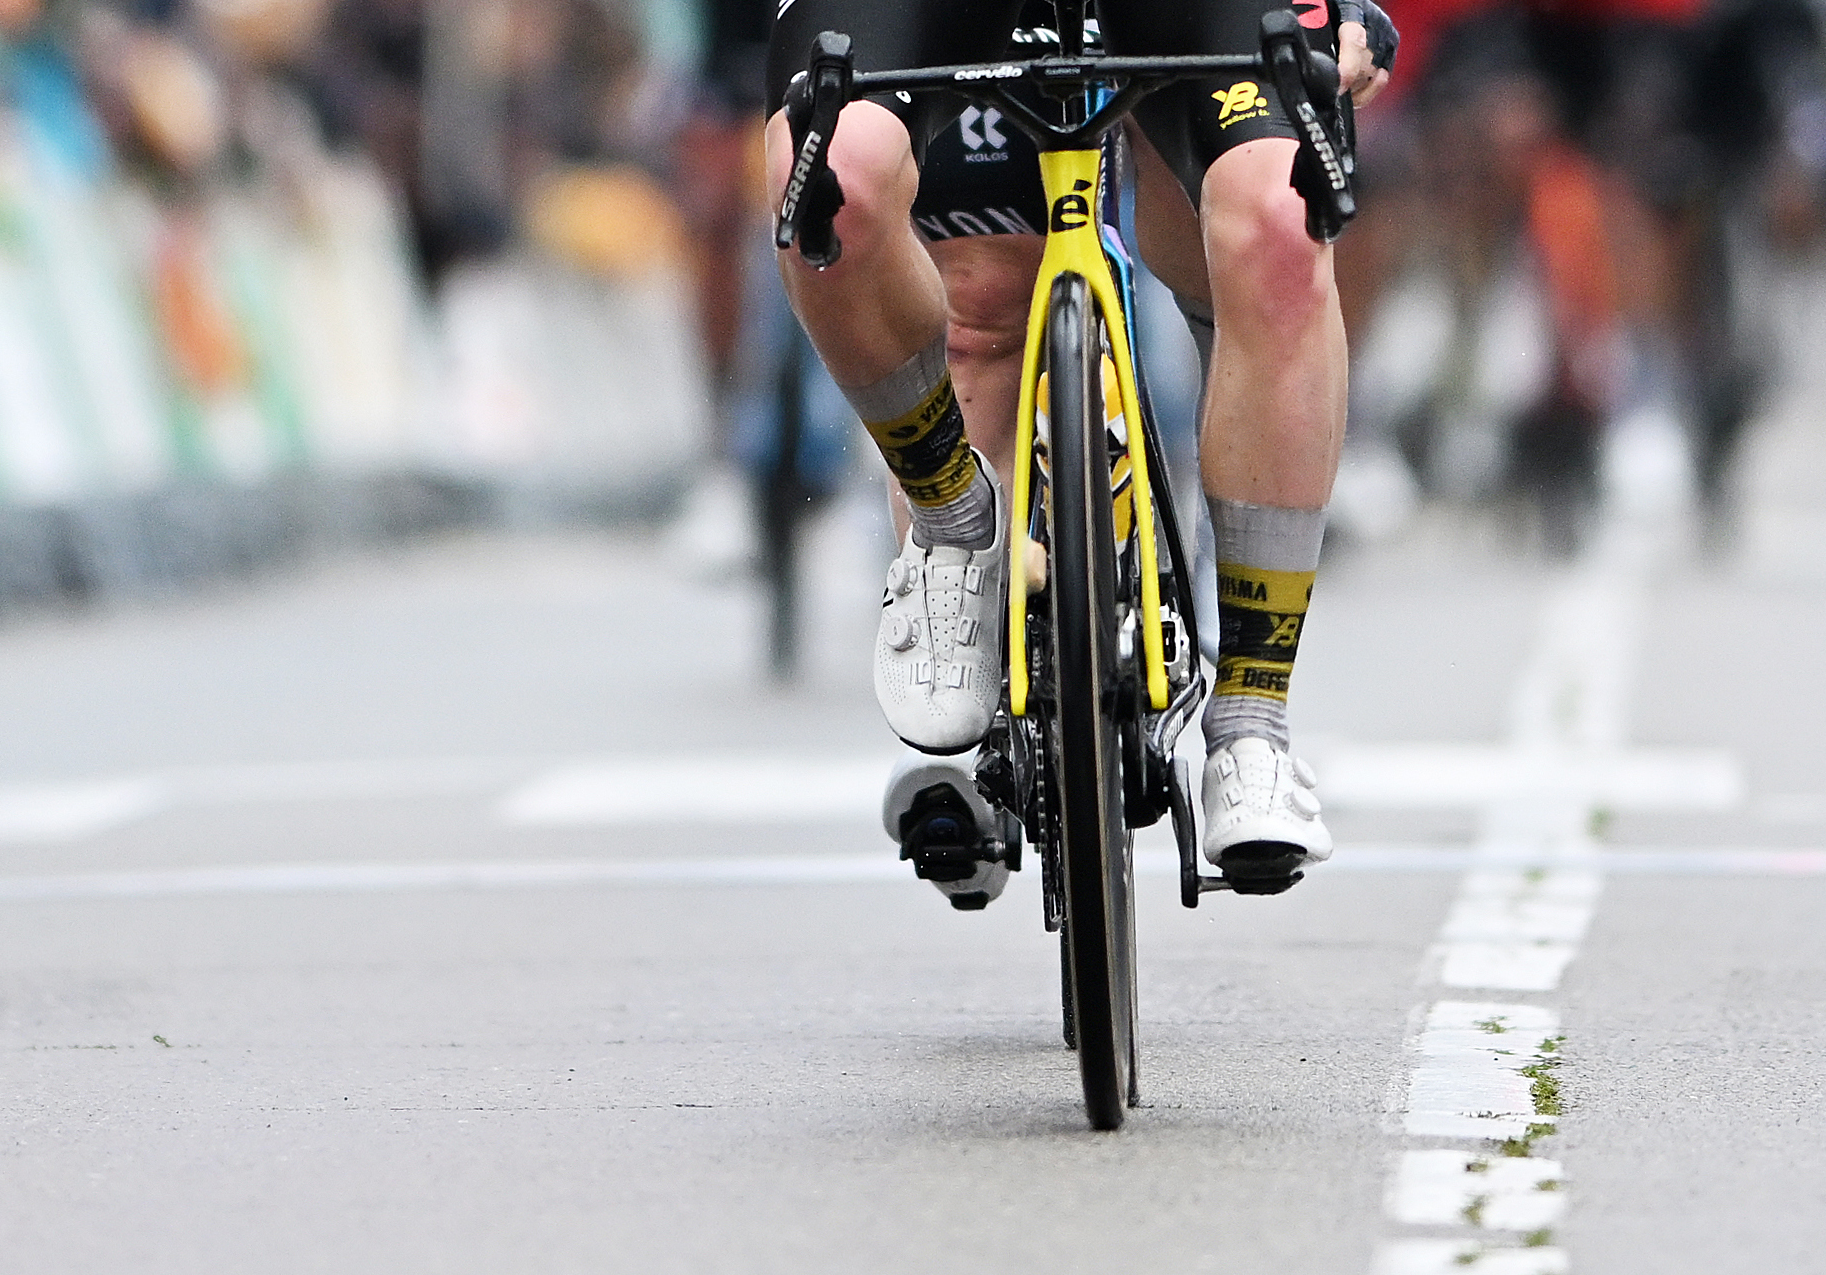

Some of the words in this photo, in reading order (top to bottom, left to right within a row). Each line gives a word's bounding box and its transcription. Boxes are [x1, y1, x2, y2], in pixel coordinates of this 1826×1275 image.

[954, 66, 1023, 81] cervélo
[781, 130, 822, 222] SRAM
[1296, 101, 1346, 191] SRAM
